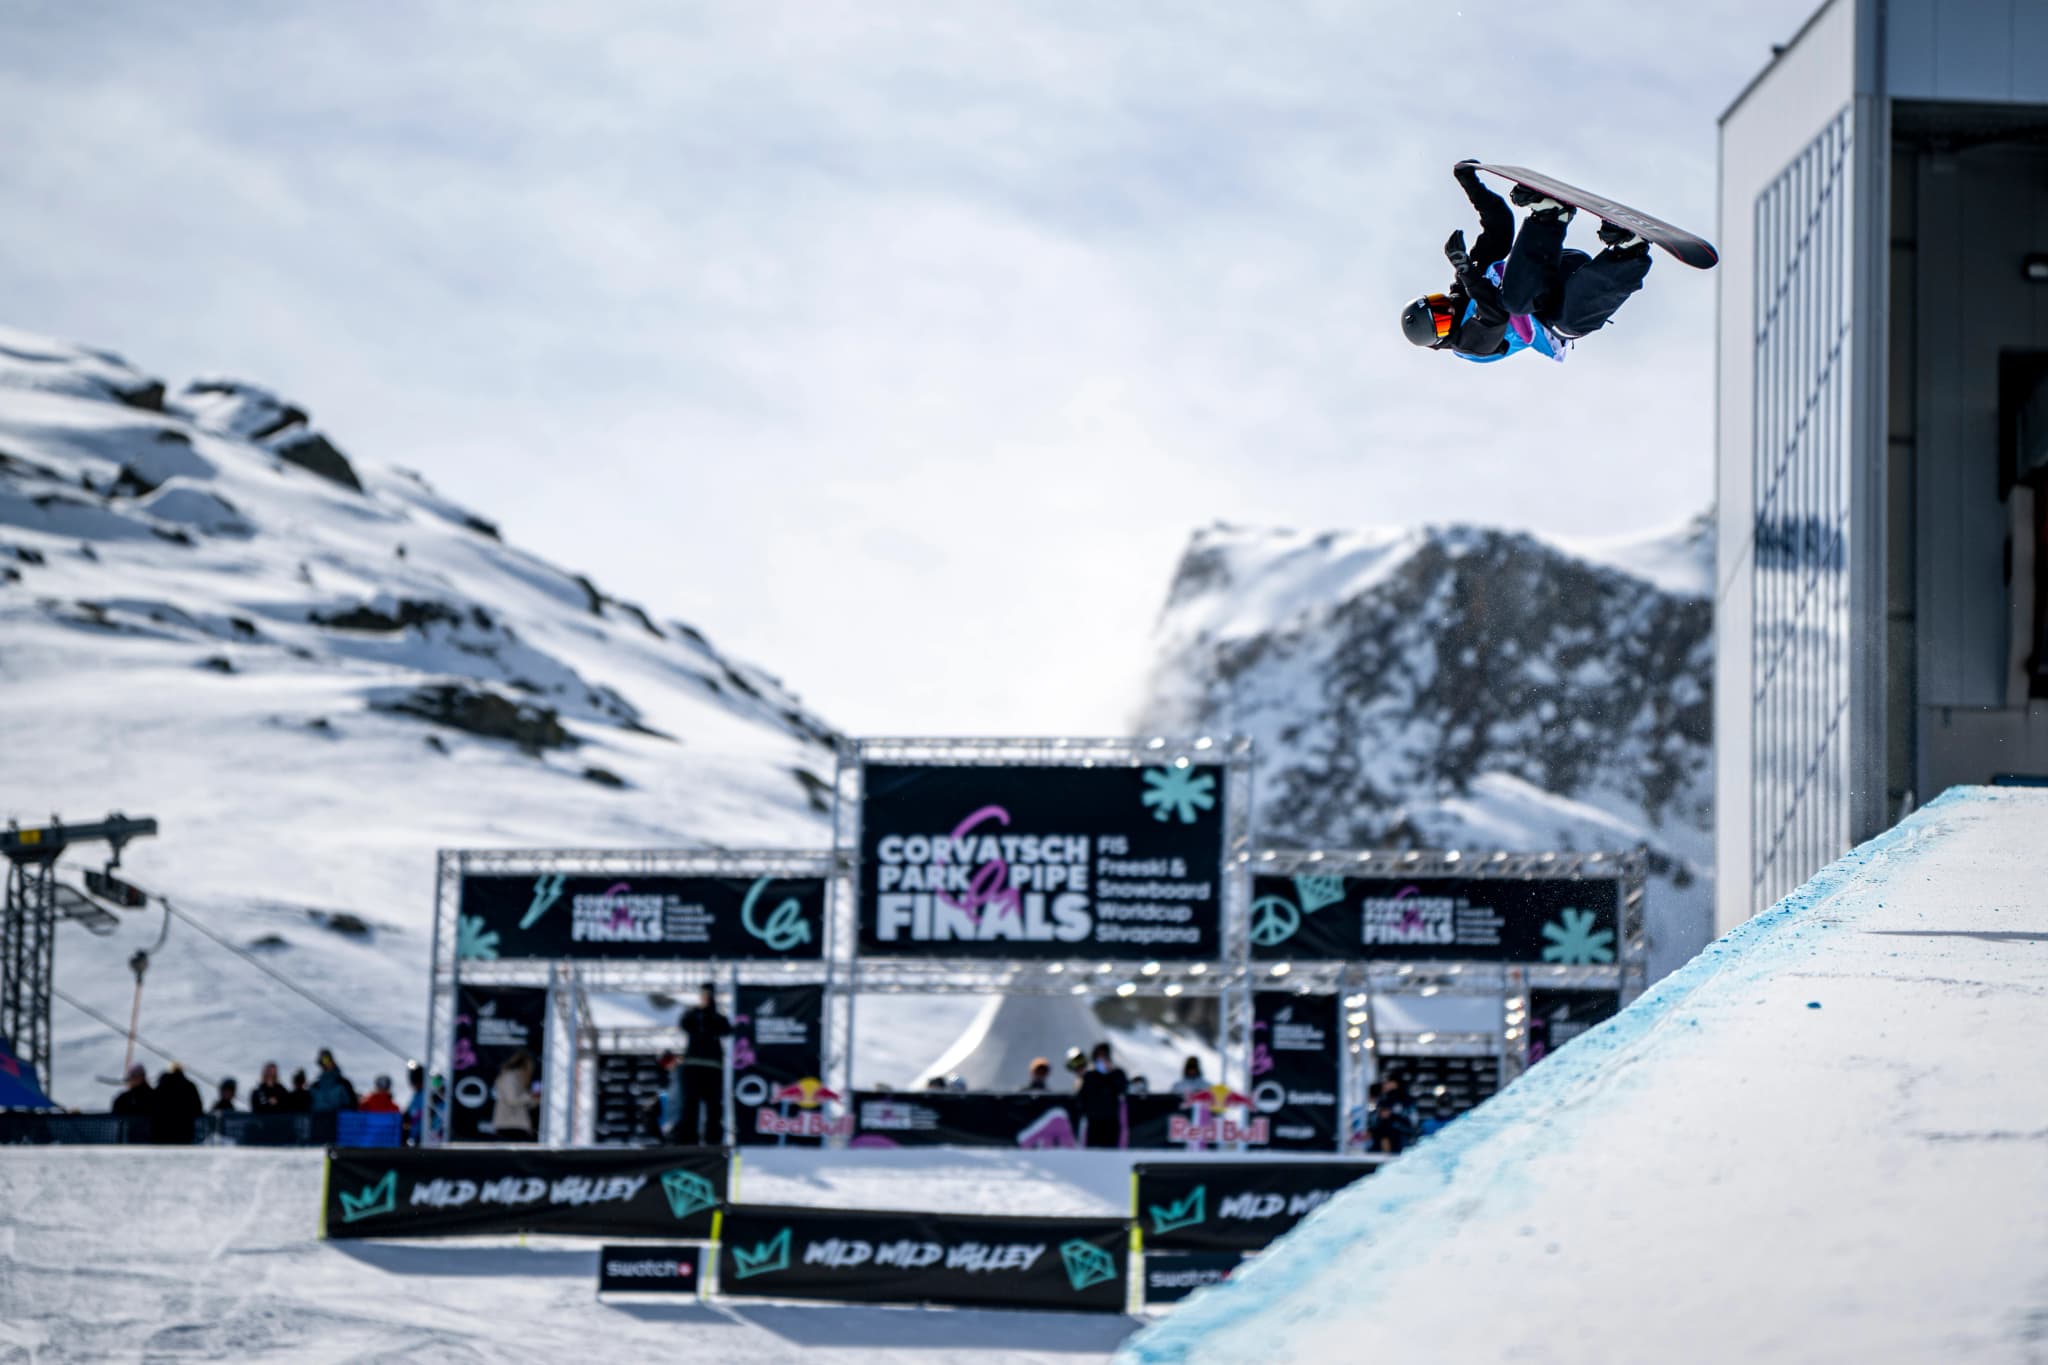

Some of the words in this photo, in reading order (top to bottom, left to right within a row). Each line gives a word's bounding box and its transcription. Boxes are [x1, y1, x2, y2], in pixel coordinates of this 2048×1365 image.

[877, 834, 1090, 864] CORVATSCH
[1097, 835, 1129, 855] FIS
[877, 864, 972, 891] PARK
[1009, 864, 1090, 891] PIPE
[876, 892, 1093, 942] FINALS
[757, 1107, 805, 1136] Red
[809, 1109, 855, 1137] Bull
[1169, 1115, 1219, 1143] Red
[1221, 1117, 1270, 1144] Bull
[607, 1259, 678, 1277] swatch
